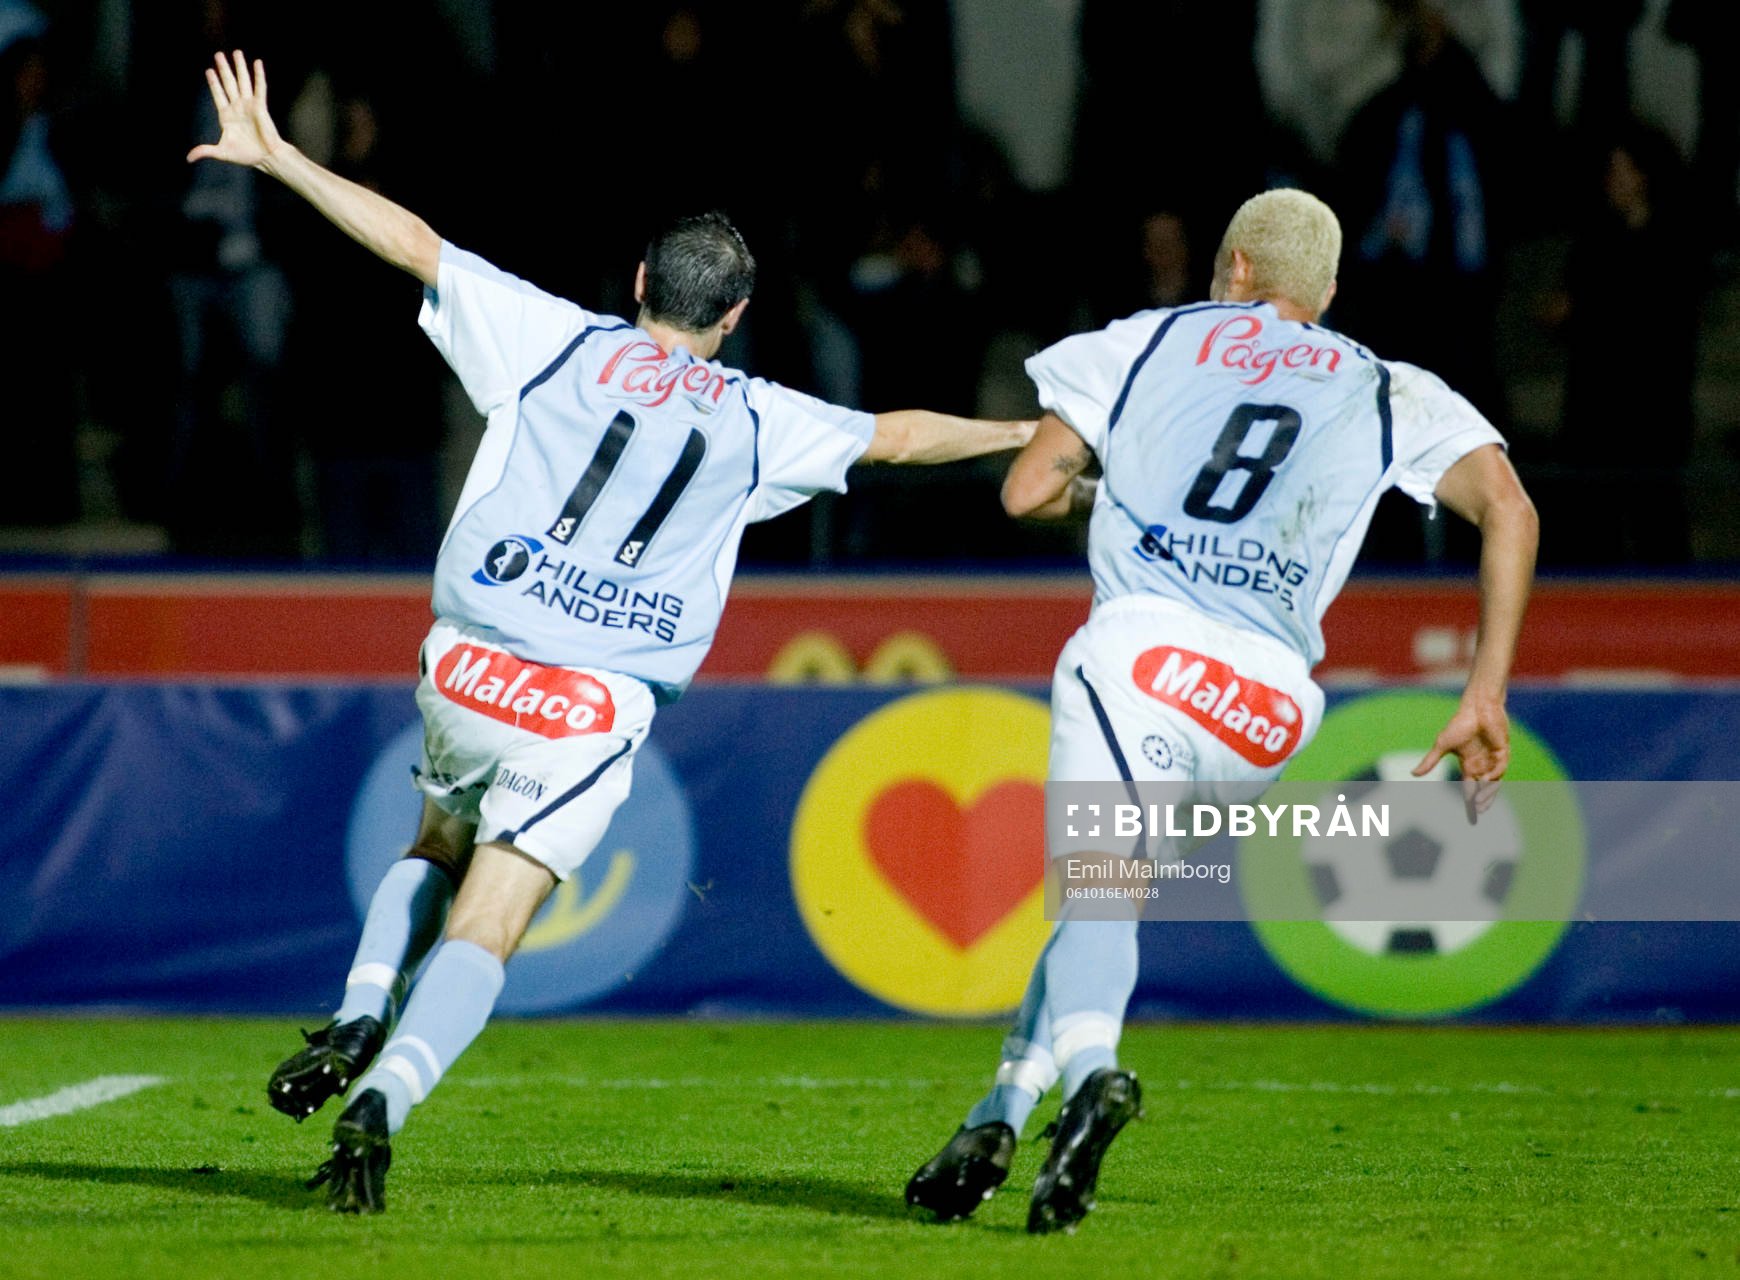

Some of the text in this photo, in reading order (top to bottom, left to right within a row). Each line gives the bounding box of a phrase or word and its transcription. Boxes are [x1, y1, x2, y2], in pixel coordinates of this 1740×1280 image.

[597, 341, 725, 407] Pågen
[1195, 315, 1341, 385] Pågen
[544, 409, 706, 568] 11
[1183, 402, 1302, 524] 8
[535, 554, 684, 619] HILDING
[1168, 532, 1308, 586] HILDNG
[521, 580, 678, 643] ANDERS
[444, 650, 597, 730] Malaco
[1151, 652, 1288, 752] Malaco
